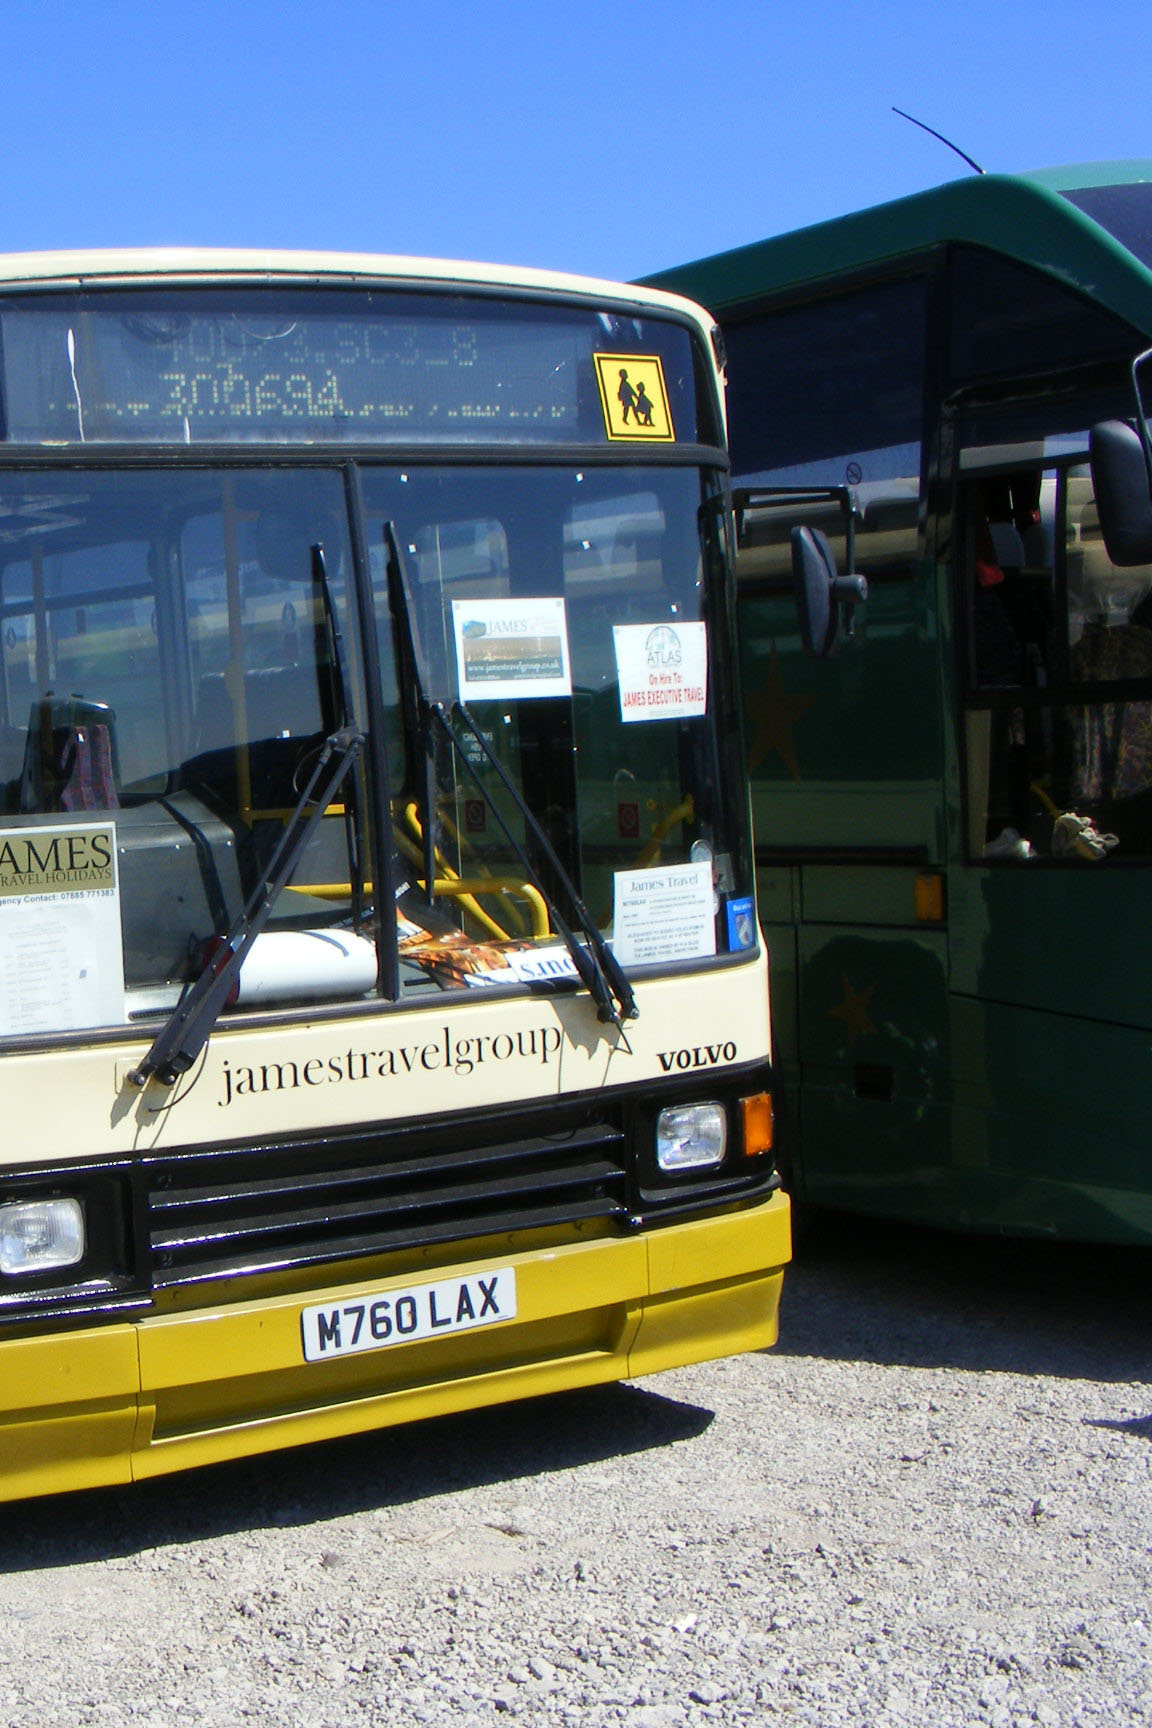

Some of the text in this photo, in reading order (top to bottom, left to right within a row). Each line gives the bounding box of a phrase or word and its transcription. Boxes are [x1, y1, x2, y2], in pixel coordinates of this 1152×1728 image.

[487, 619, 528, 636] JAMES
[647, 650, 682, 665] ATLAS
[649, 674, 658, 685] On
[623, 687, 704, 707] JAMES EXECUTIVE TRAVEL
[46, 867, 113, 884] HOLIDAYS
[629, 873, 699, 893] James Travel
[23, 893, 58, 903] Contact:
[61, 892, 84, 900] 07885
[656, 1041, 737, 1072] VOLVO
[218, 1026, 562, 1107] jamestravelgroup
[317, 1276, 500, 1352] M760 LAX
